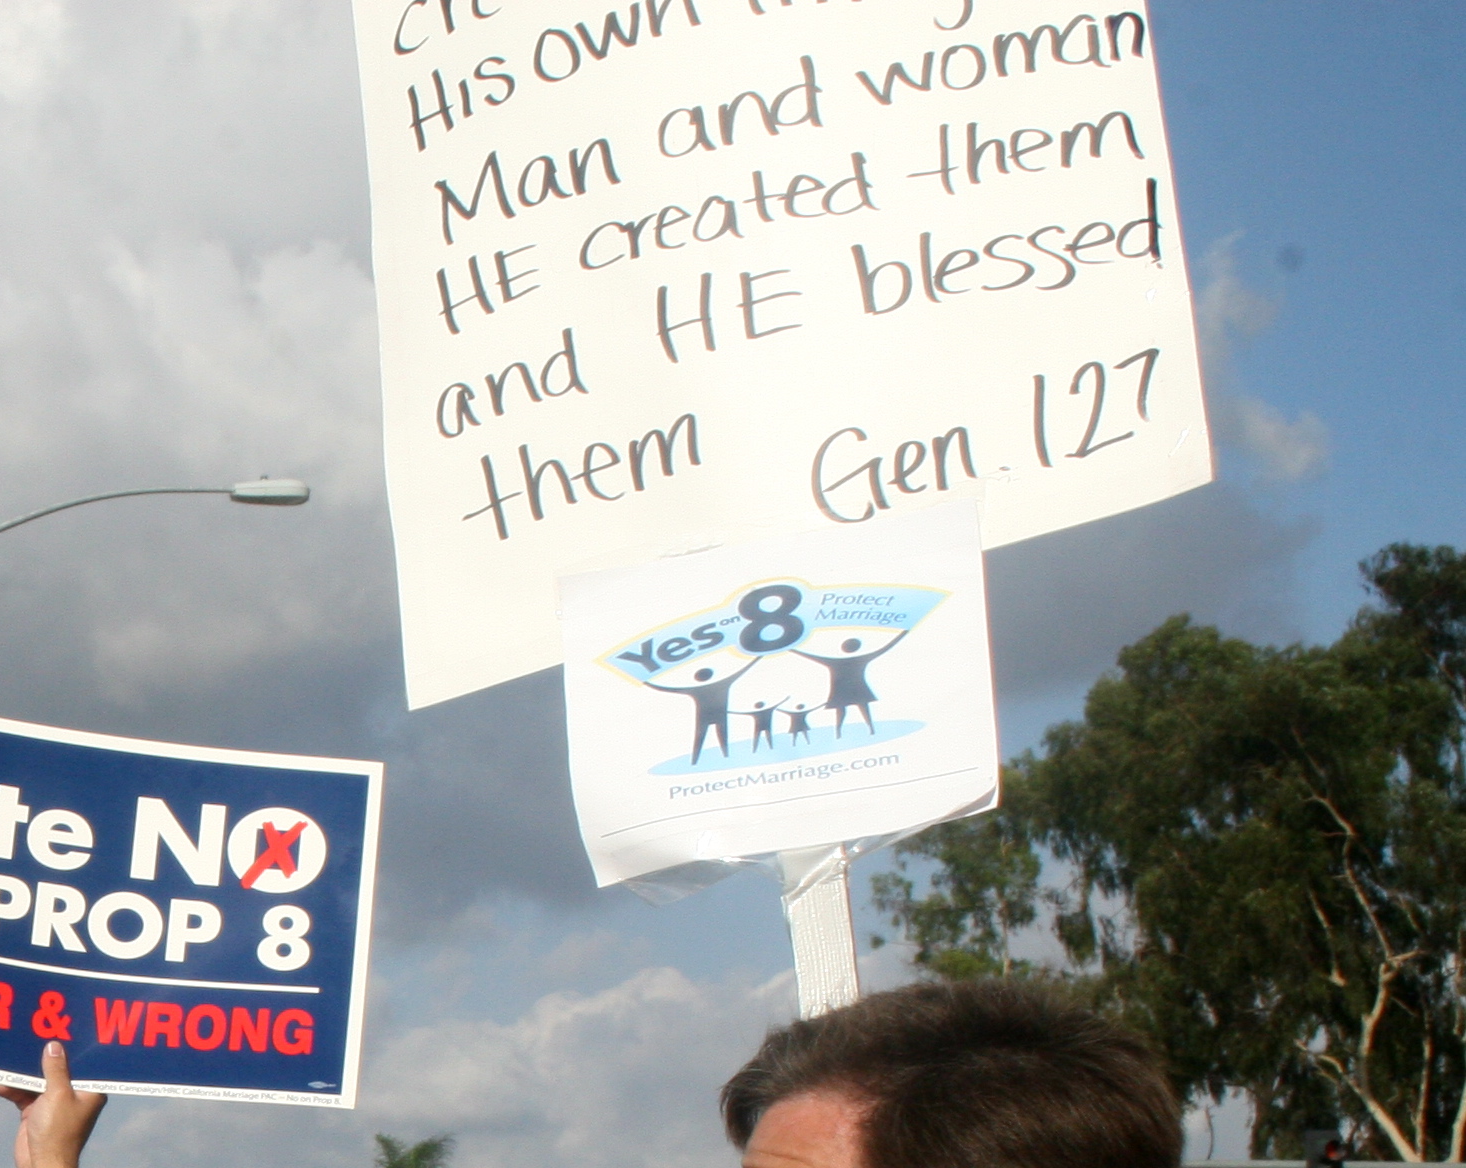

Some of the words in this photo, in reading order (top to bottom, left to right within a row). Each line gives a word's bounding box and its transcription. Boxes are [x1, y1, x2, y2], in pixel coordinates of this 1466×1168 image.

[435, 138, 621, 245] Man
[658, 55, 823, 157] and
[854, 11, 1145, 105] woman
[436, 244, 542, 335] HE
[579, 151, 879, 271] created
[908, 110, 1146, 196] them
[436, 328, 588, 438] and
[656, 268, 803, 362] HE
[852, 178, 1162, 315] blessed
[462, 412, 702, 542] them
[617, 621, 724, 674] Yes
[719, 613, 740, 627] on
[738, 584, 805, 653] 8
[814, 607, 908, 626] Marriage
[820, 592, 895, 608] Protect
[669, 752, 900, 800] ProtectMarriage.com
[130, 796, 327, 894] NO
[256, 905, 311, 971] 8
[31, 991, 72, 1042] &
[95, 998, 314, 1056] WRONG
[6, 1074, 42, 1088] California
[91, 1083, 117, 1092] Rights
[223, 1091, 259, 1101] Marriage
